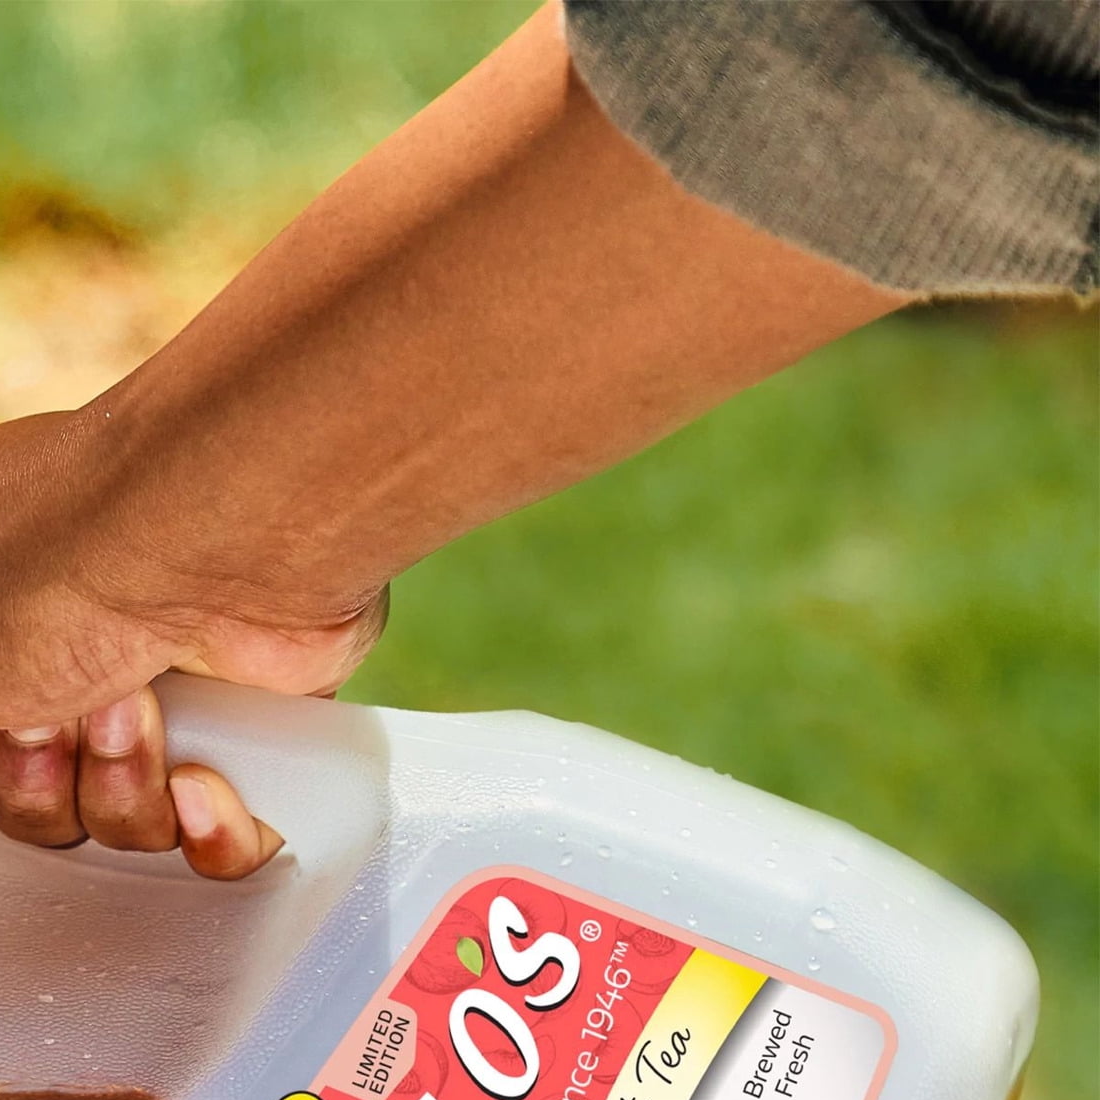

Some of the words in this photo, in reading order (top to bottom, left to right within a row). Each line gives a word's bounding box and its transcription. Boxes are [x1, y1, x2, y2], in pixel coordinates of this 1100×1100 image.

[352, 1008, 393, 1089] LIMITED
[369, 1016, 411, 1094] EDITION
[635, 1028, 691, 1085] Tea
[742, 1009, 792, 1099] Brewed
[774, 1034, 815, 1097] Fresh
